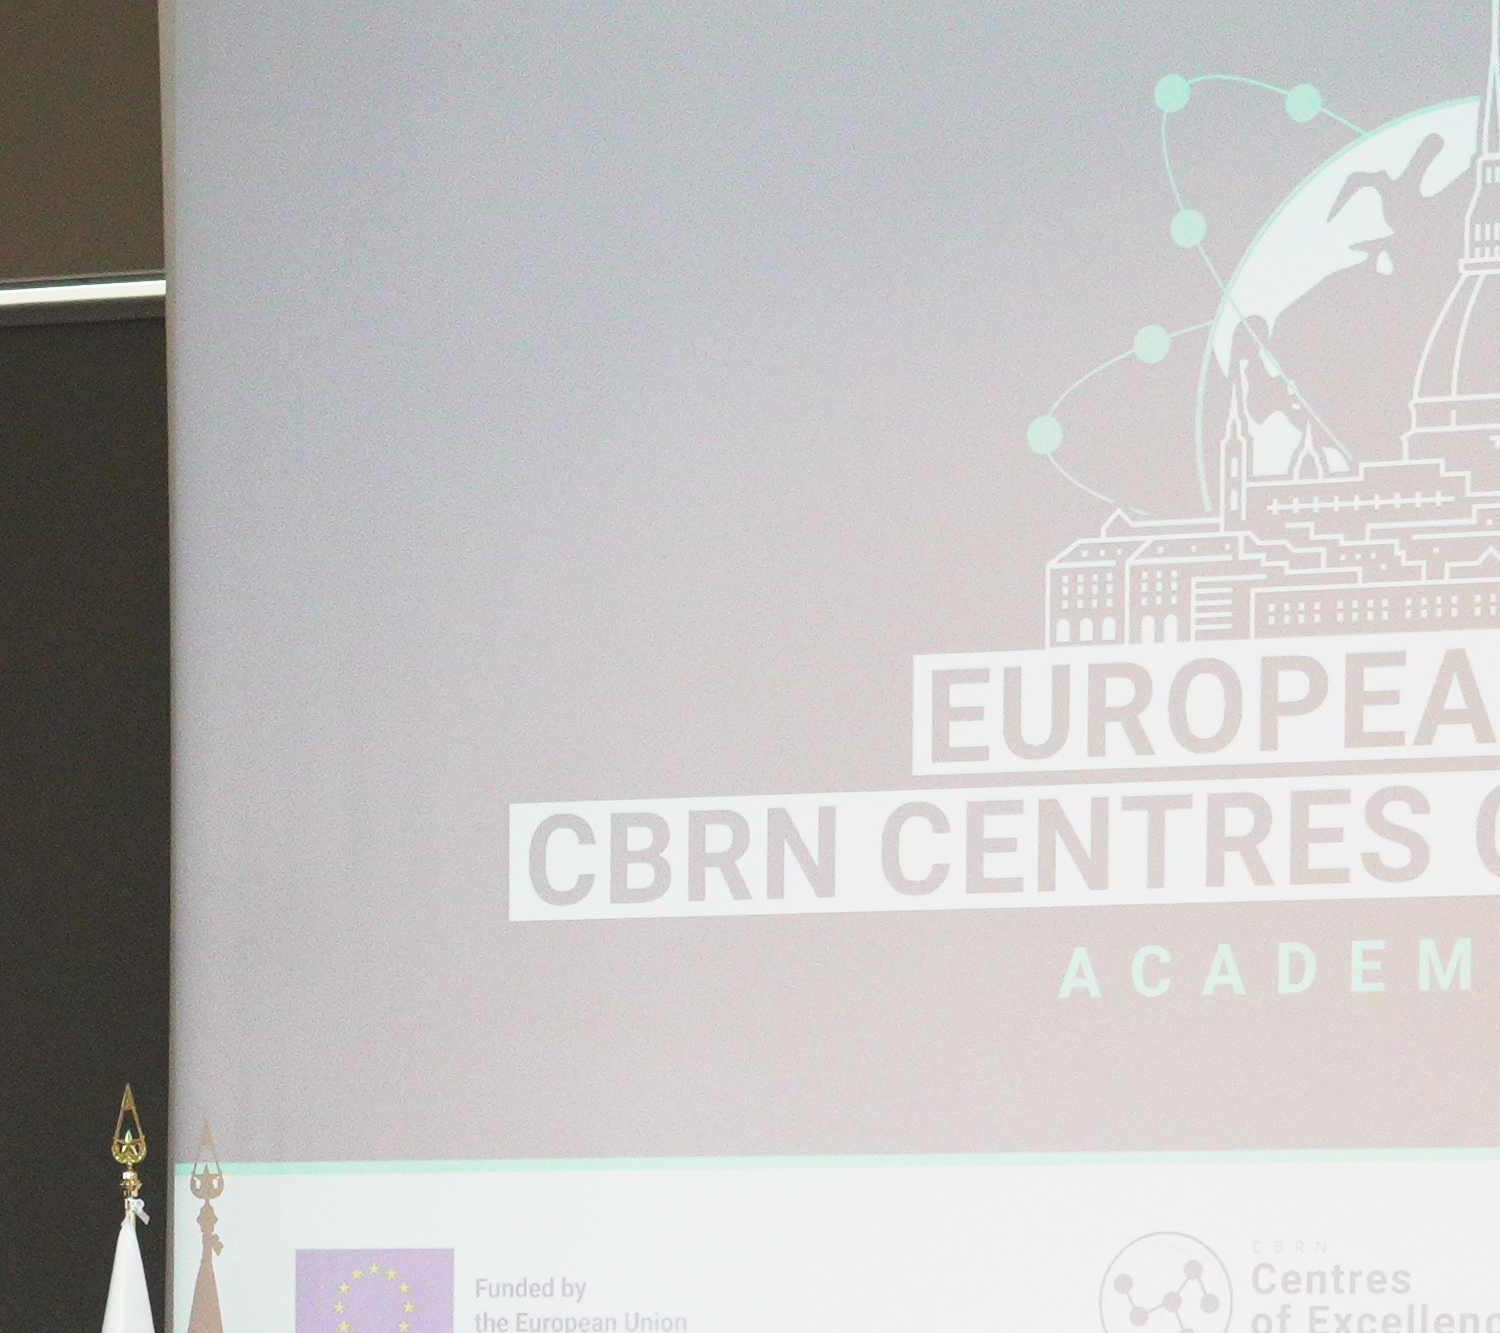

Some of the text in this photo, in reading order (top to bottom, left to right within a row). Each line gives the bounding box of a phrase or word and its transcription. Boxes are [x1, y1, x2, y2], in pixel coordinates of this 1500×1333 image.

[527, 804, 837, 909] CBRN
[879, 785, 1432, 896] CENTRES
[1252, 1239, 1328, 1255] CBRN
[475, 1277, 587, 1303] Funded by
[1251, 1261, 1413, 1295] Centres
[474, 1312, 508, 1333] the
[624, 1312, 687, 1333] Union
